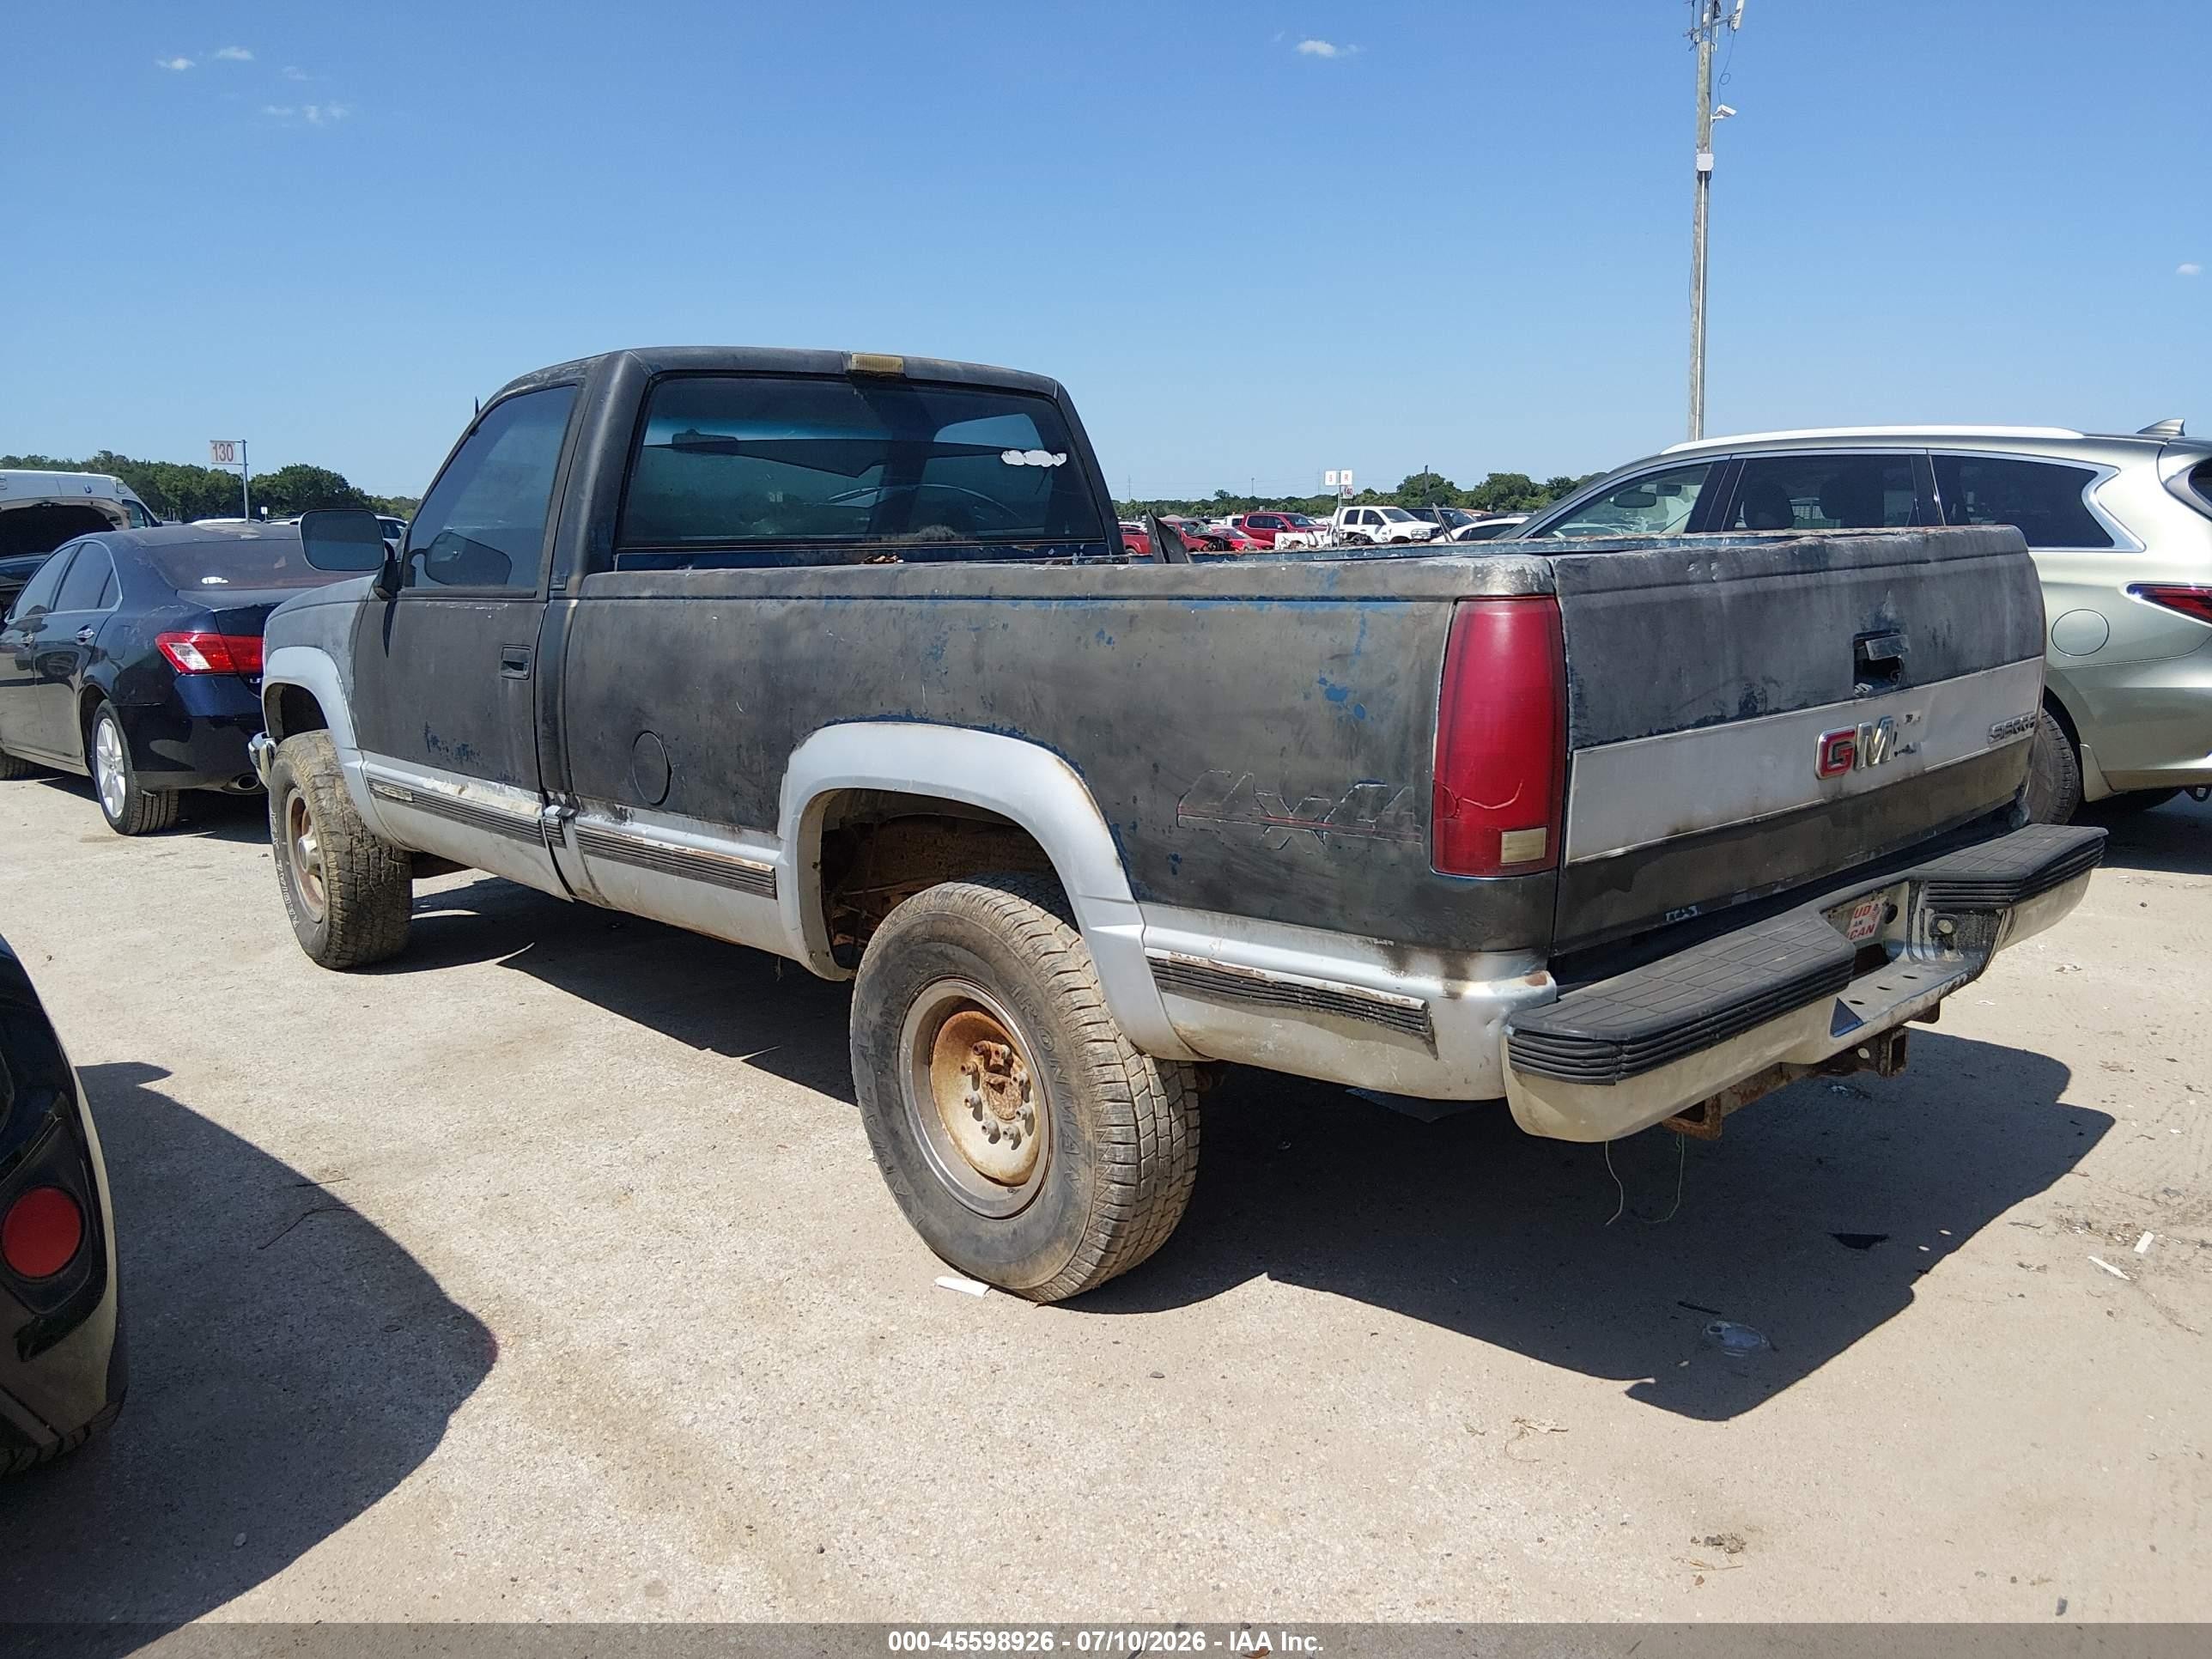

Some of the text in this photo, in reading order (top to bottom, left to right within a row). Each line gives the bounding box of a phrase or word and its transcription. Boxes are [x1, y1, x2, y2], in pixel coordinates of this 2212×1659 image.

[212, 443, 234, 462] 130
[1344, 487, 1353, 495] 140
[1010, 985, 1082, 1195] IRONMAN
